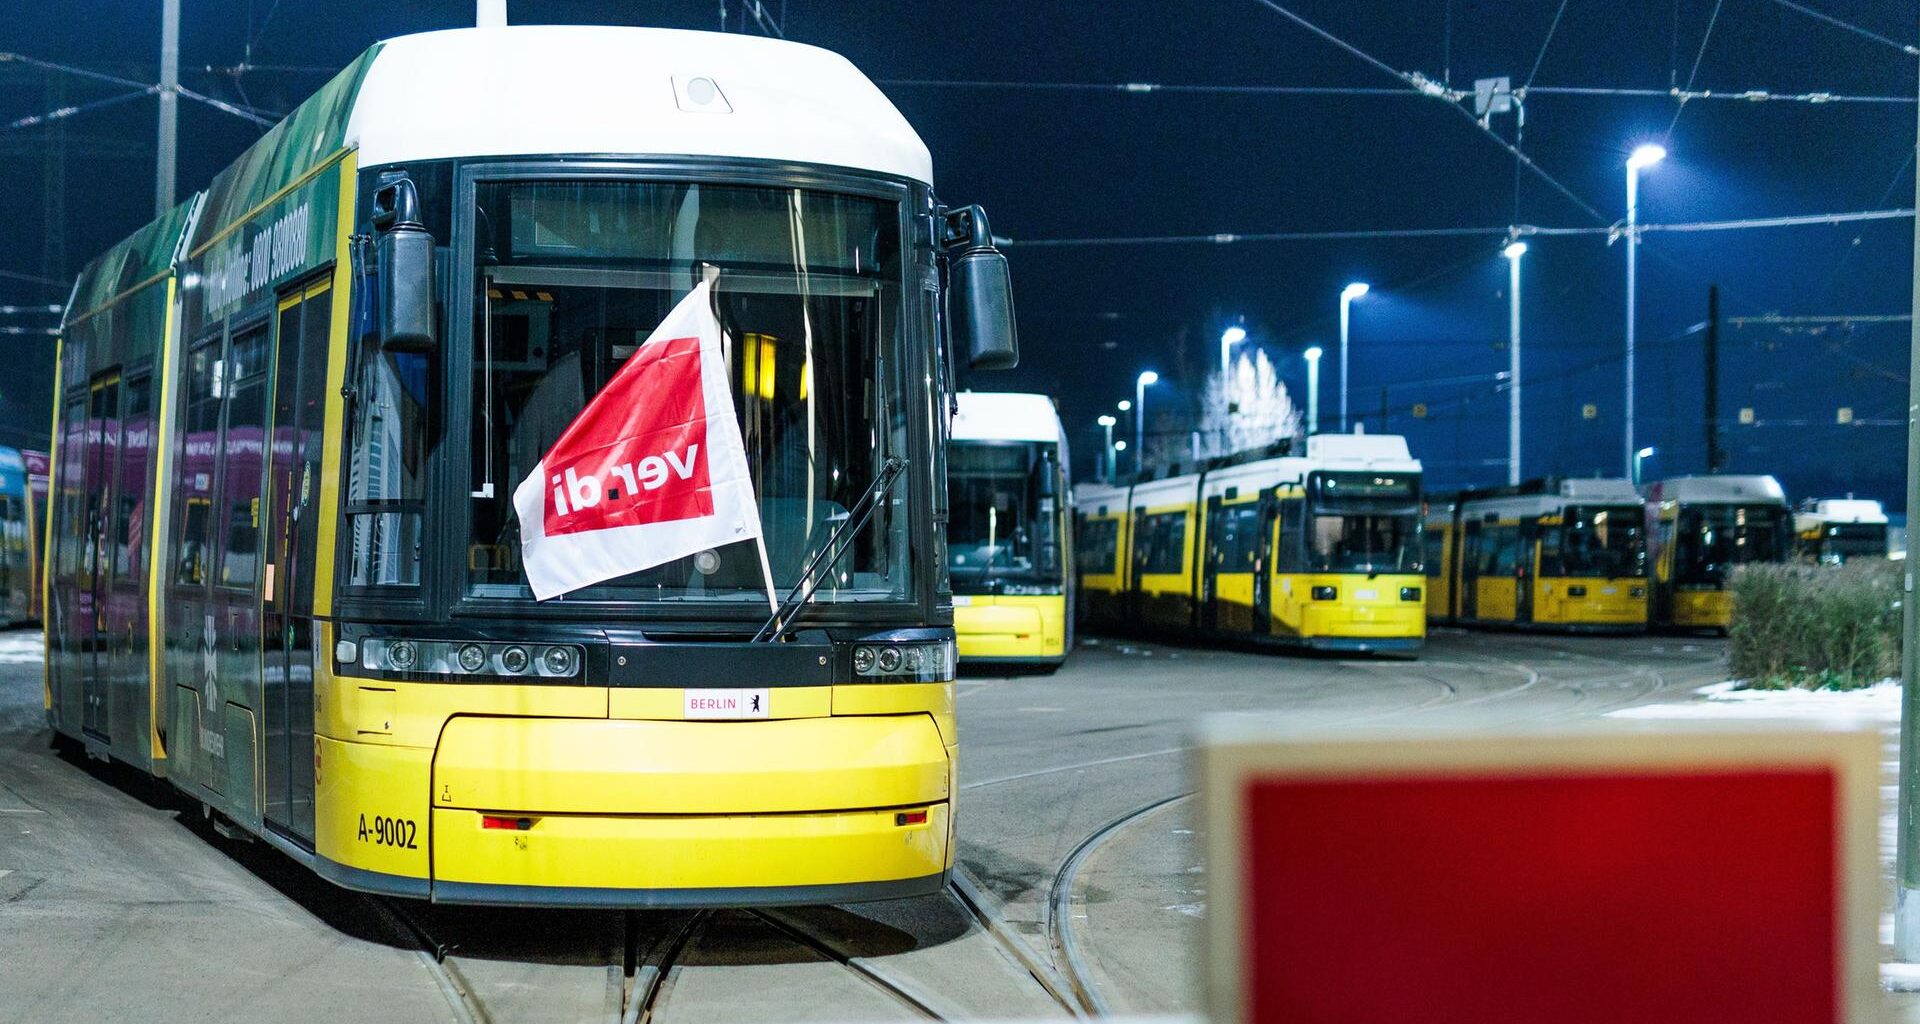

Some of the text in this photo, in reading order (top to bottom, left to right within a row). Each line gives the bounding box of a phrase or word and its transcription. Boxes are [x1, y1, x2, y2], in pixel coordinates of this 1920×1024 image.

[251, 226, 272, 292] 0800
[690, 698, 736, 710] BERLIN
[358, 813, 418, 850] A-9002
